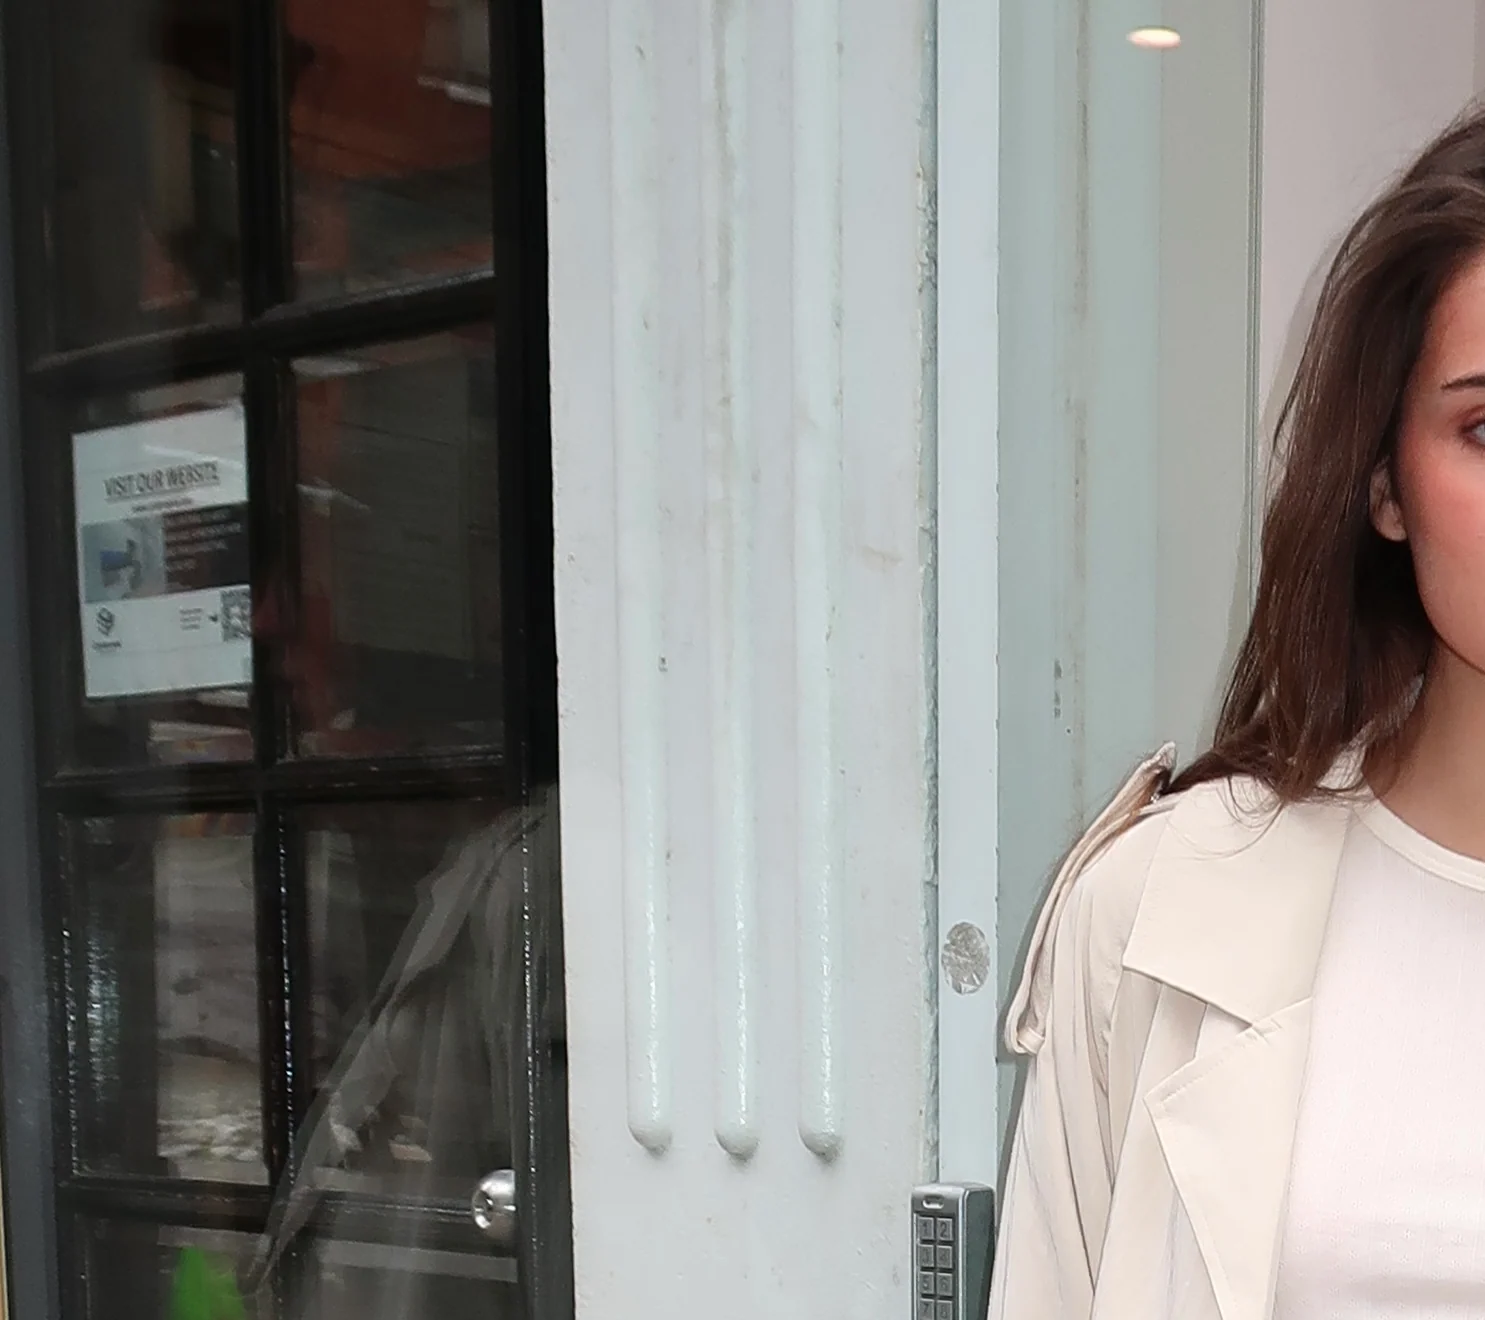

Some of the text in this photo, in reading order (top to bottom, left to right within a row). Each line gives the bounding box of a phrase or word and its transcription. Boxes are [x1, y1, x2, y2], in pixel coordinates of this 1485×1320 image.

[103, 461, 220, 496] VISIT OUR WEBSITE
